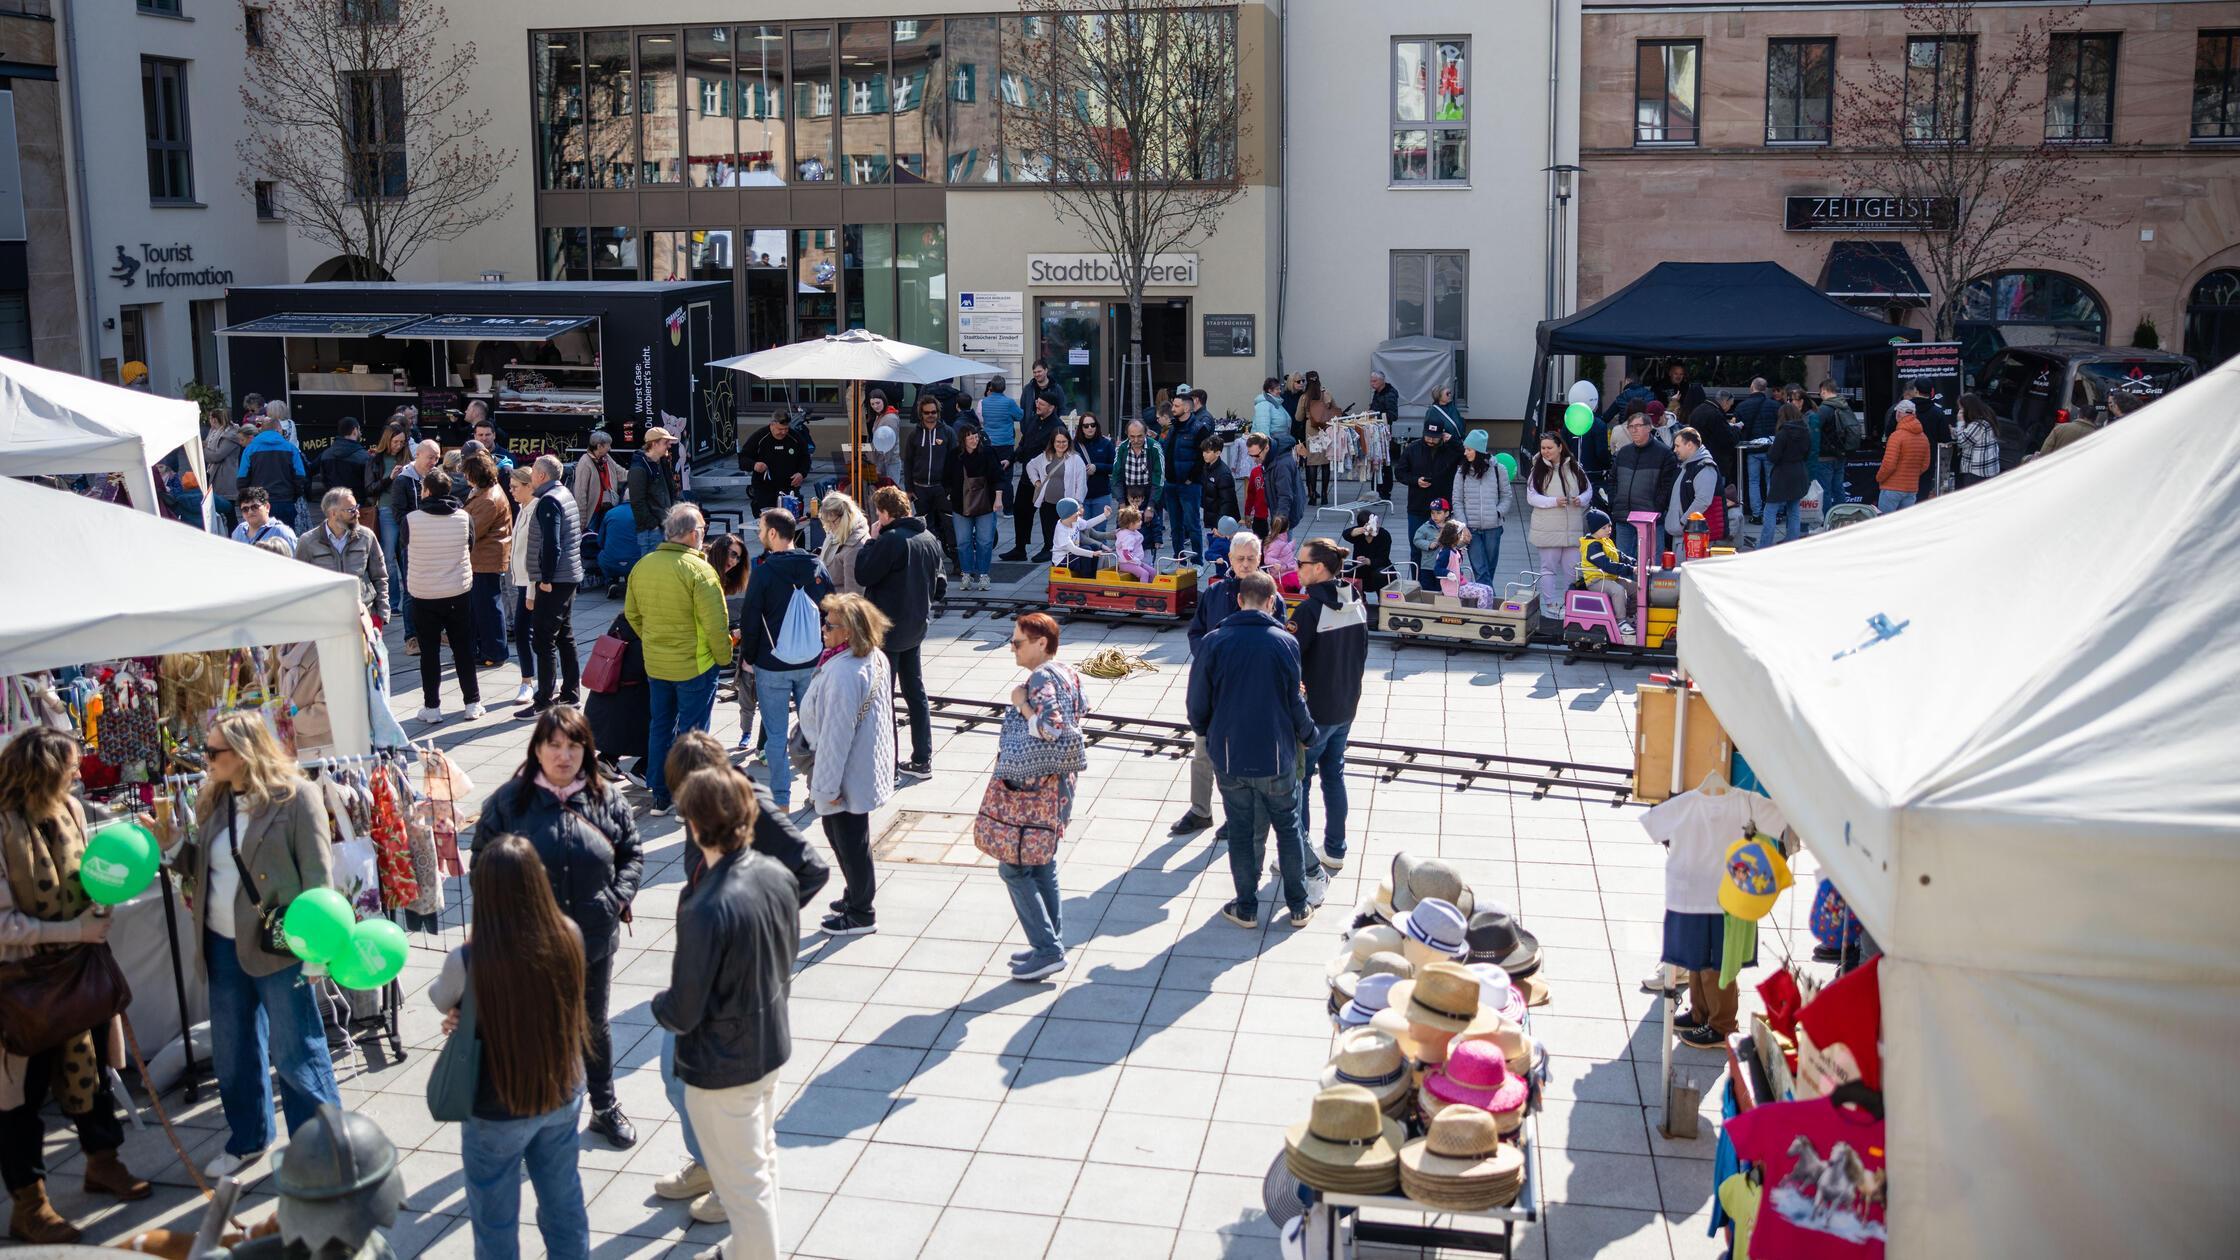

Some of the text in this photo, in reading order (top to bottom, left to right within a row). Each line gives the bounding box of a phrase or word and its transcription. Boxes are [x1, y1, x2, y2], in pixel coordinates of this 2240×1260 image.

[1813, 199, 1934, 217] ZEITGEIST
[139, 242, 195, 263] Tourist
[146, 265, 234, 288] Information
[642, 345, 652, 370] nicht.
[633, 363, 643, 413] Wurst Case:
[644, 417, 653, 429] Du
[302, 437, 329, 451] MADE
